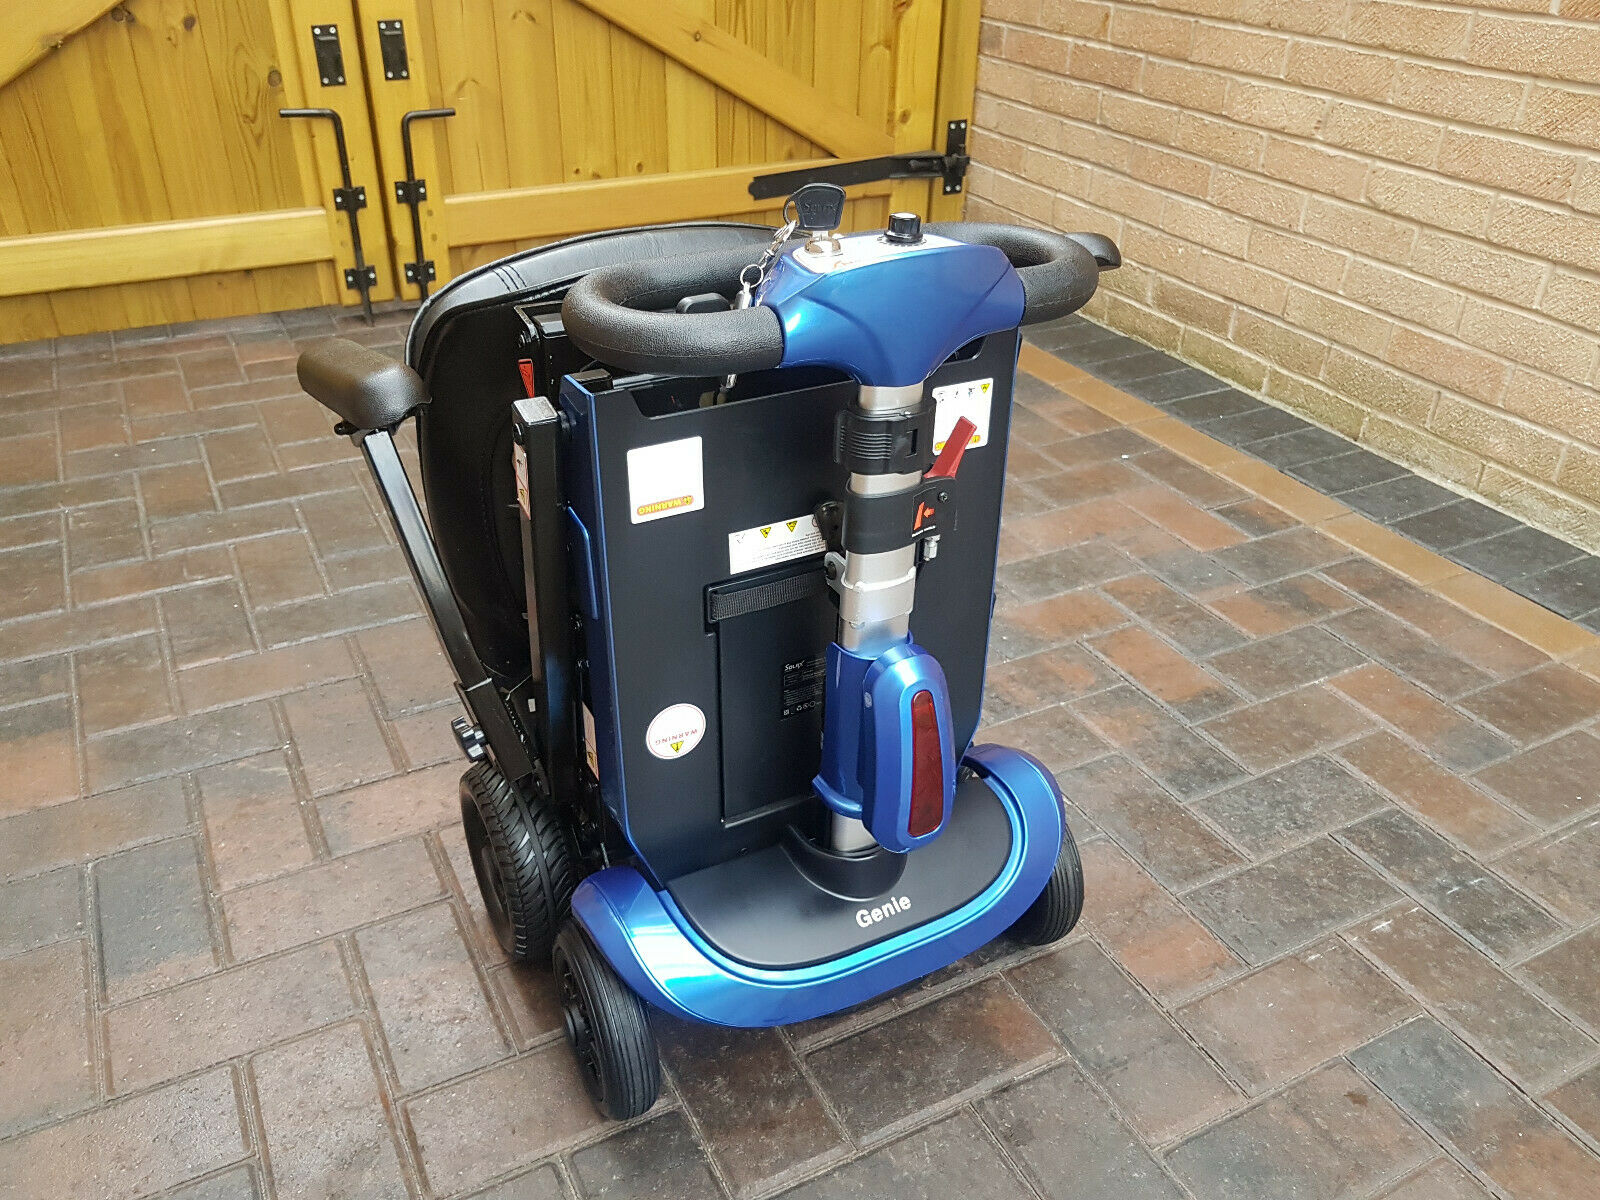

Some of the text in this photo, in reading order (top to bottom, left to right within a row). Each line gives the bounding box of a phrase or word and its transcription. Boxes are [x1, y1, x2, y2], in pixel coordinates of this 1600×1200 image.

[638, 496, 682, 516] WARNING
[655, 728, 698, 746] WARNING
[855, 896, 912, 928] Genie
